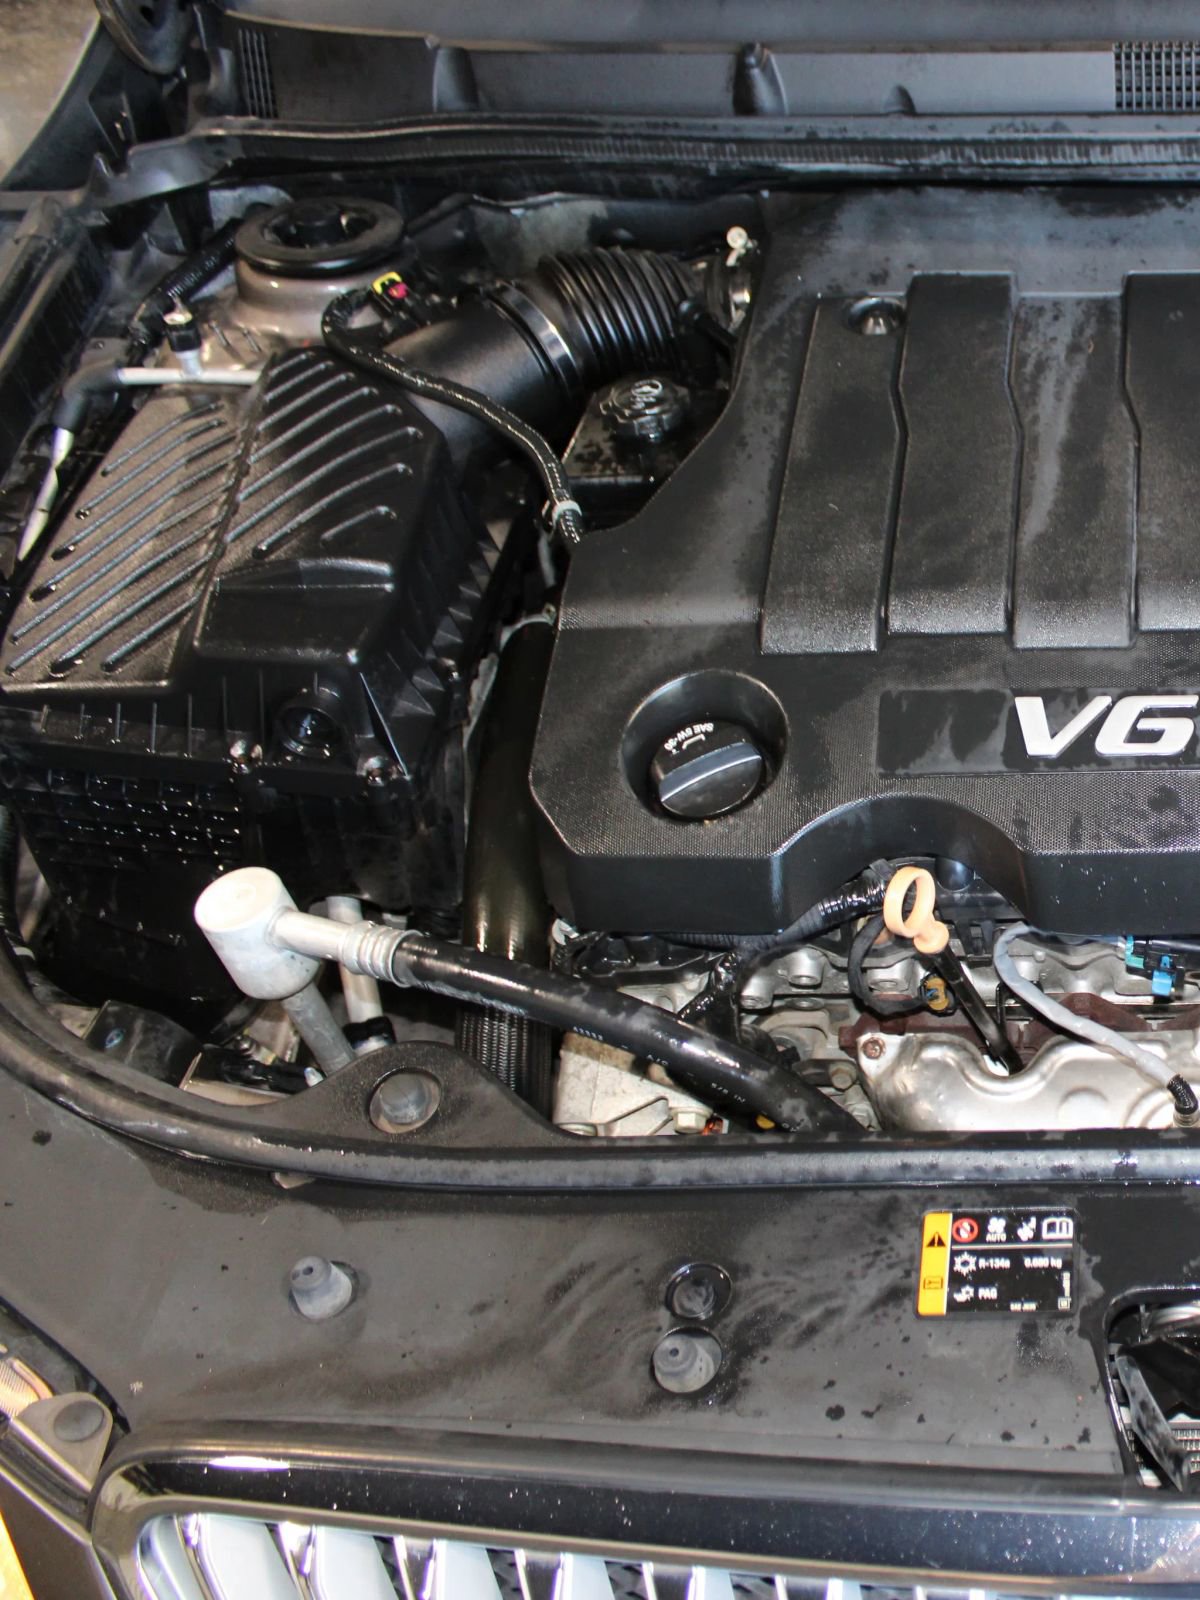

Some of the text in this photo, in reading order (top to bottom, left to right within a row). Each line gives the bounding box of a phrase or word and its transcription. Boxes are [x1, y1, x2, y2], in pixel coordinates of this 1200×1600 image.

[692, 722, 714, 735] SAE
[1014, 694, 1199, 757] V6
[985, 1233, 1007, 1243] AUTO
[1050, 1256, 1063, 1270] kg
[978, 1287, 998, 1300] PAG
